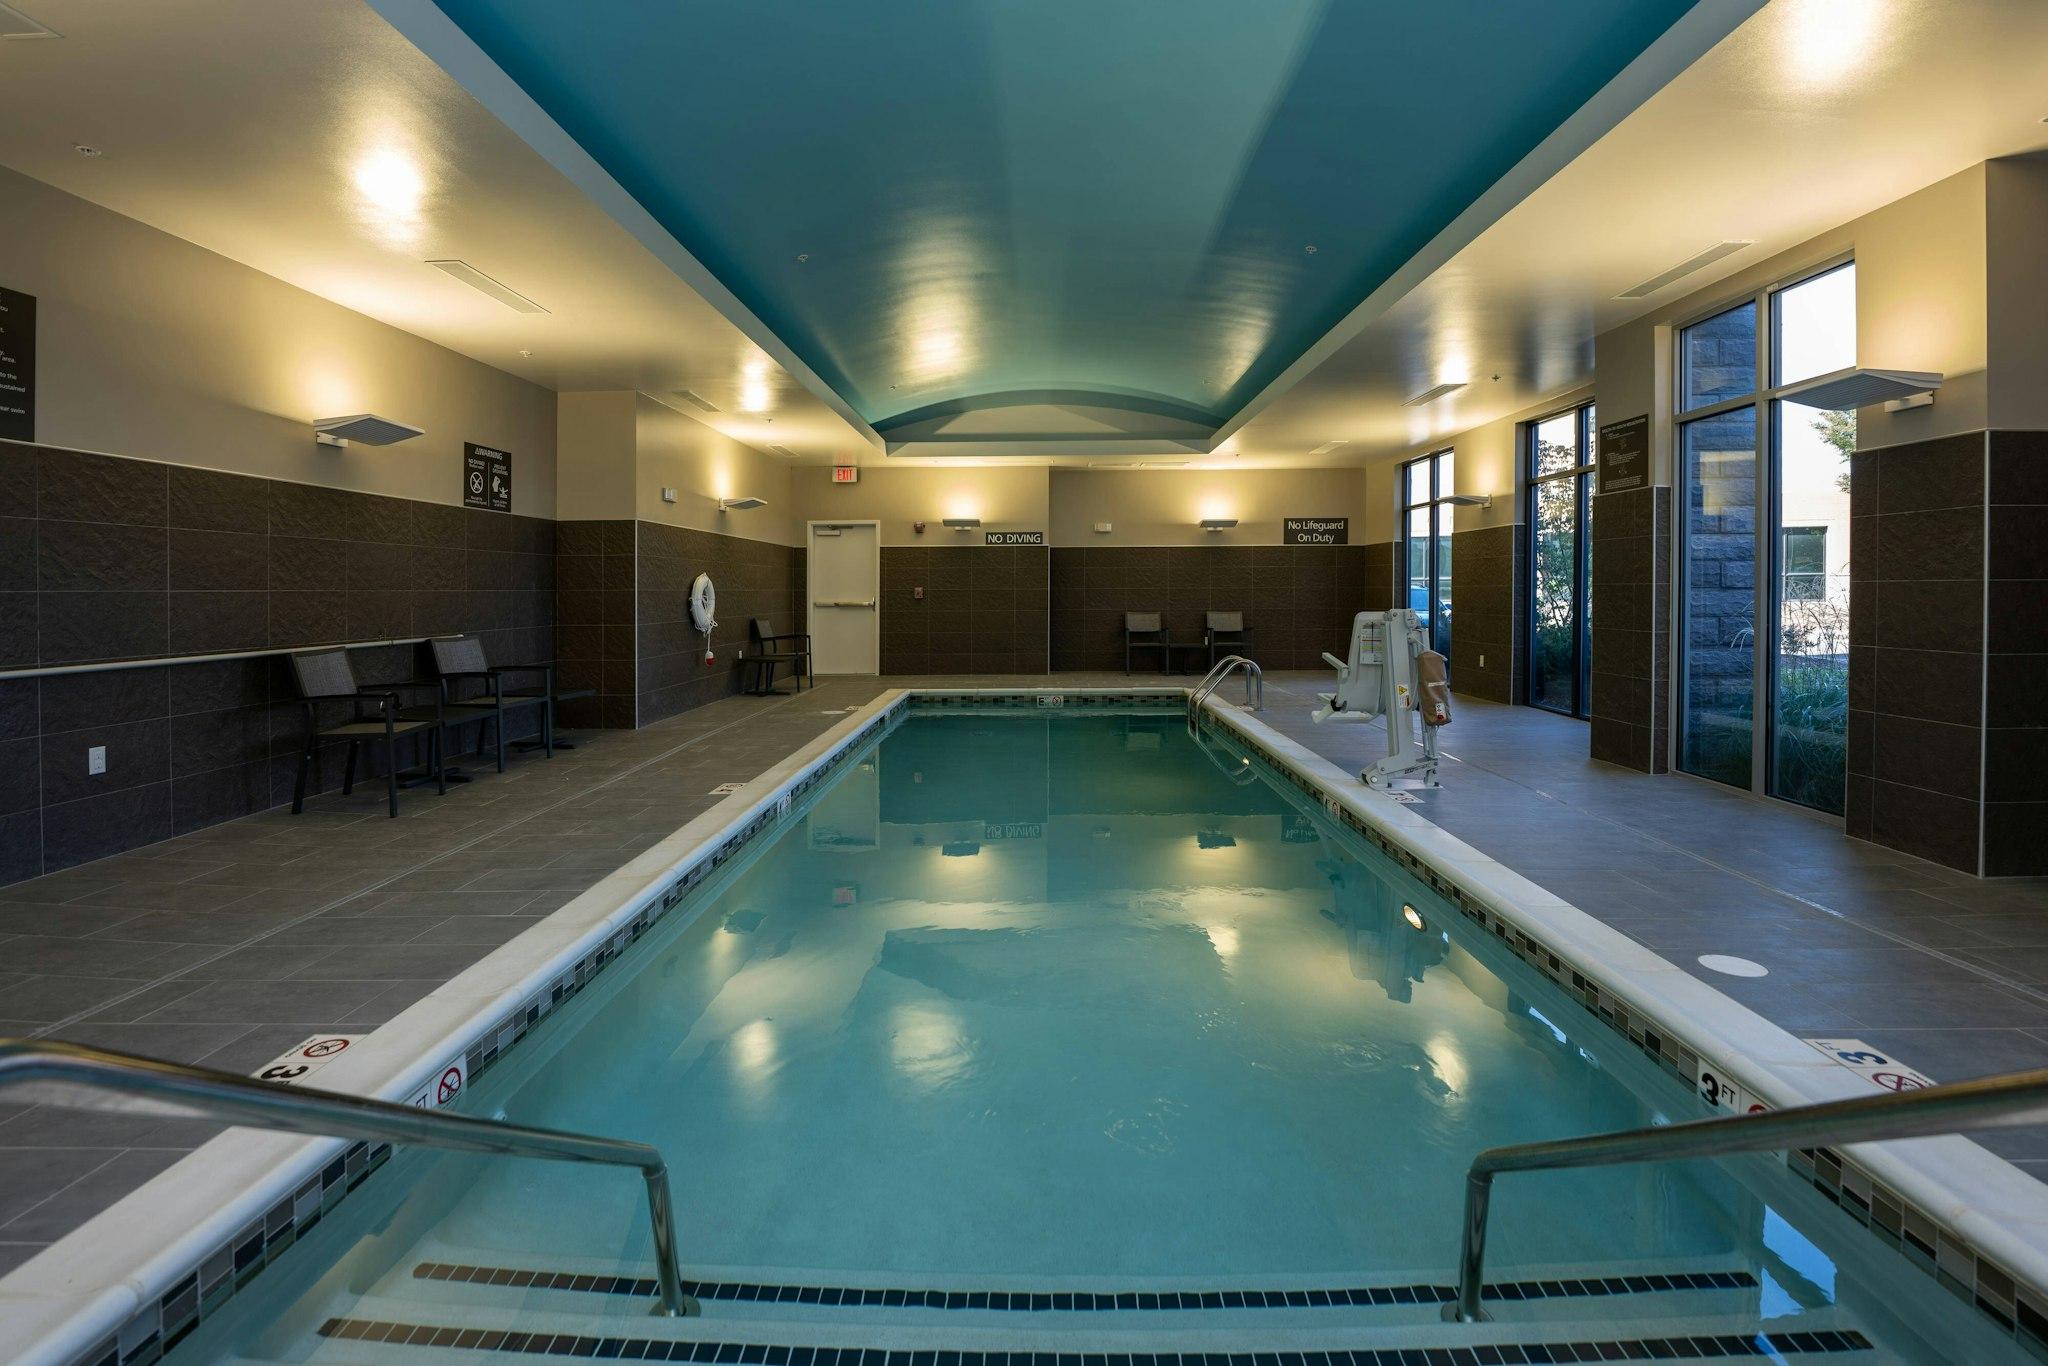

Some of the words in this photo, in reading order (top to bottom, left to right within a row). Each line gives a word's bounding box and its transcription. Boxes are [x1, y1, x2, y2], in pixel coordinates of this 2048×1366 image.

[837, 469, 852, 480] EXIT
[1288, 521, 1301, 529] No
[1303, 520, 1343, 531] Lifeguard
[987, 533, 1003, 543] NO
[1006, 533, 1041, 543] DIVING
[1297, 533, 1311, 542] On
[1312, 533, 1335, 544] Duty
[1837, 1051, 1888, 1065] 3
[261, 1065, 309, 1079] 3
[1721, 1083, 1736, 1104] FT
